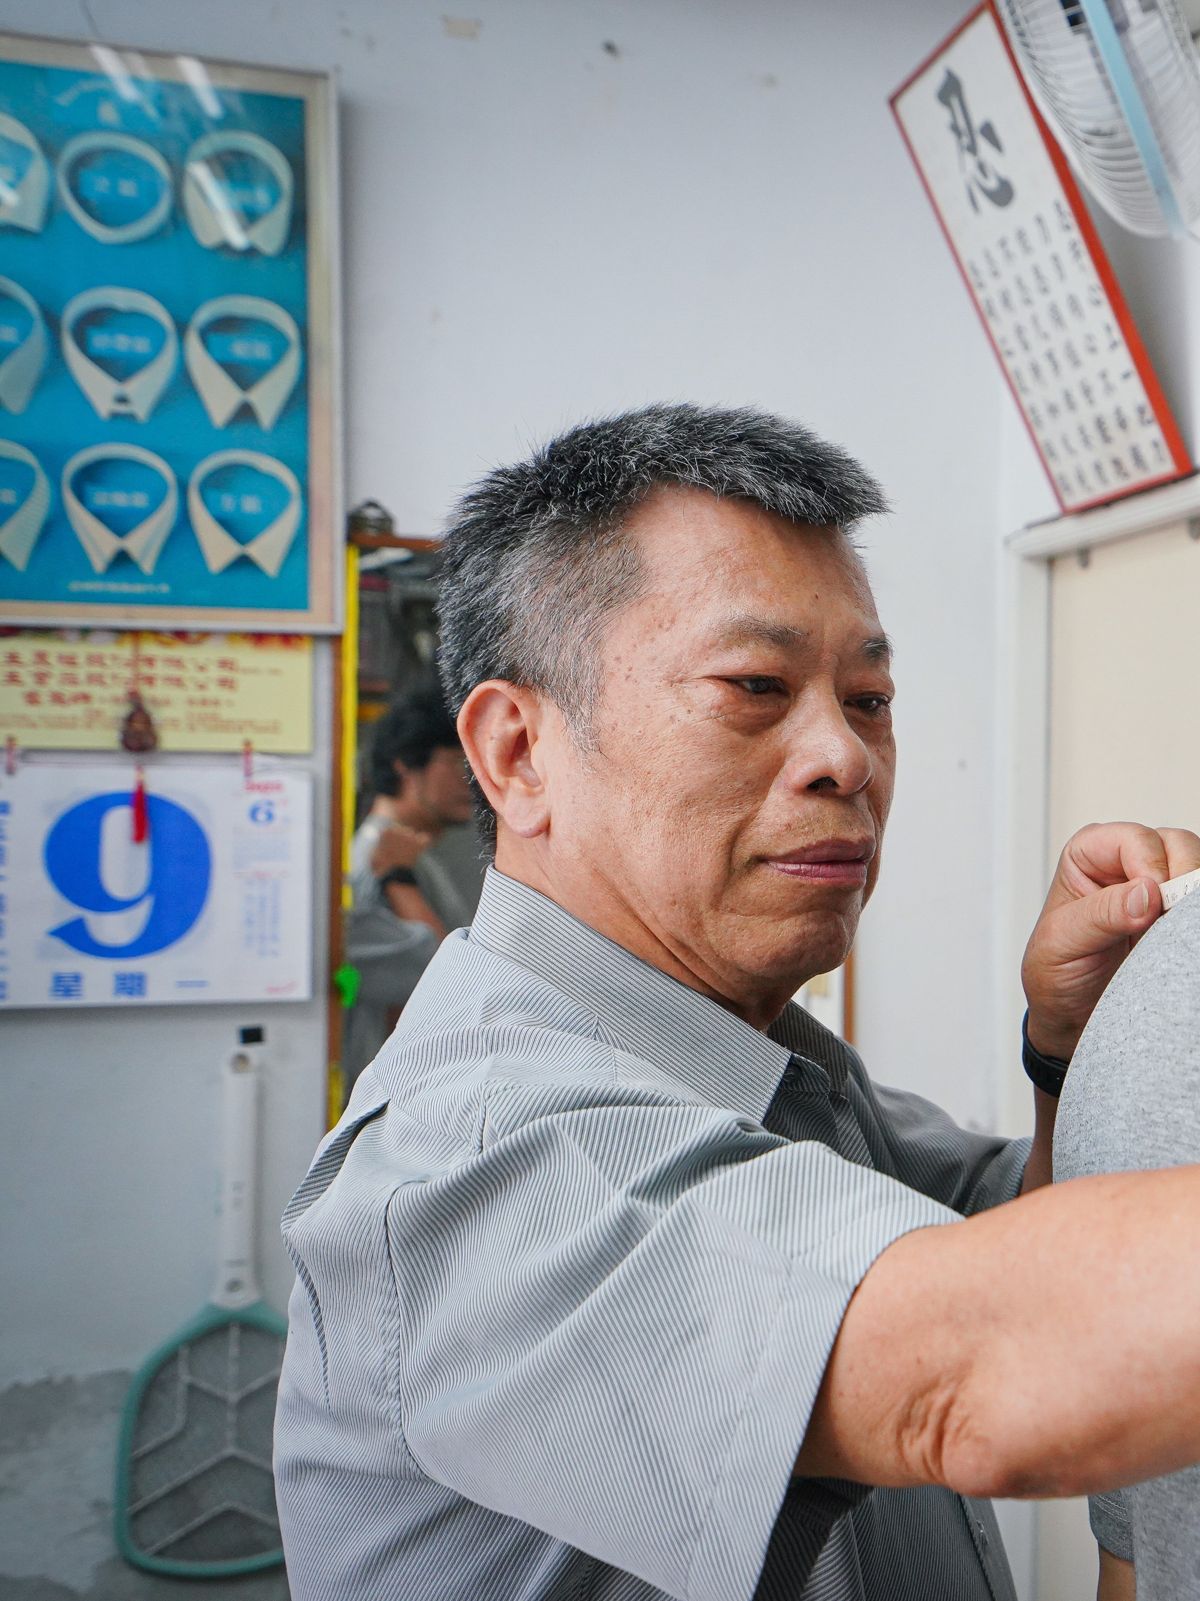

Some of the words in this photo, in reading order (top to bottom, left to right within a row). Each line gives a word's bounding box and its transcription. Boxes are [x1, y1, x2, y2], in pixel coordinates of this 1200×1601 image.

[249, 800, 275, 824] 6
[44, 791, 212, 958] 9
[51, 972, 209, 998] 星期一
